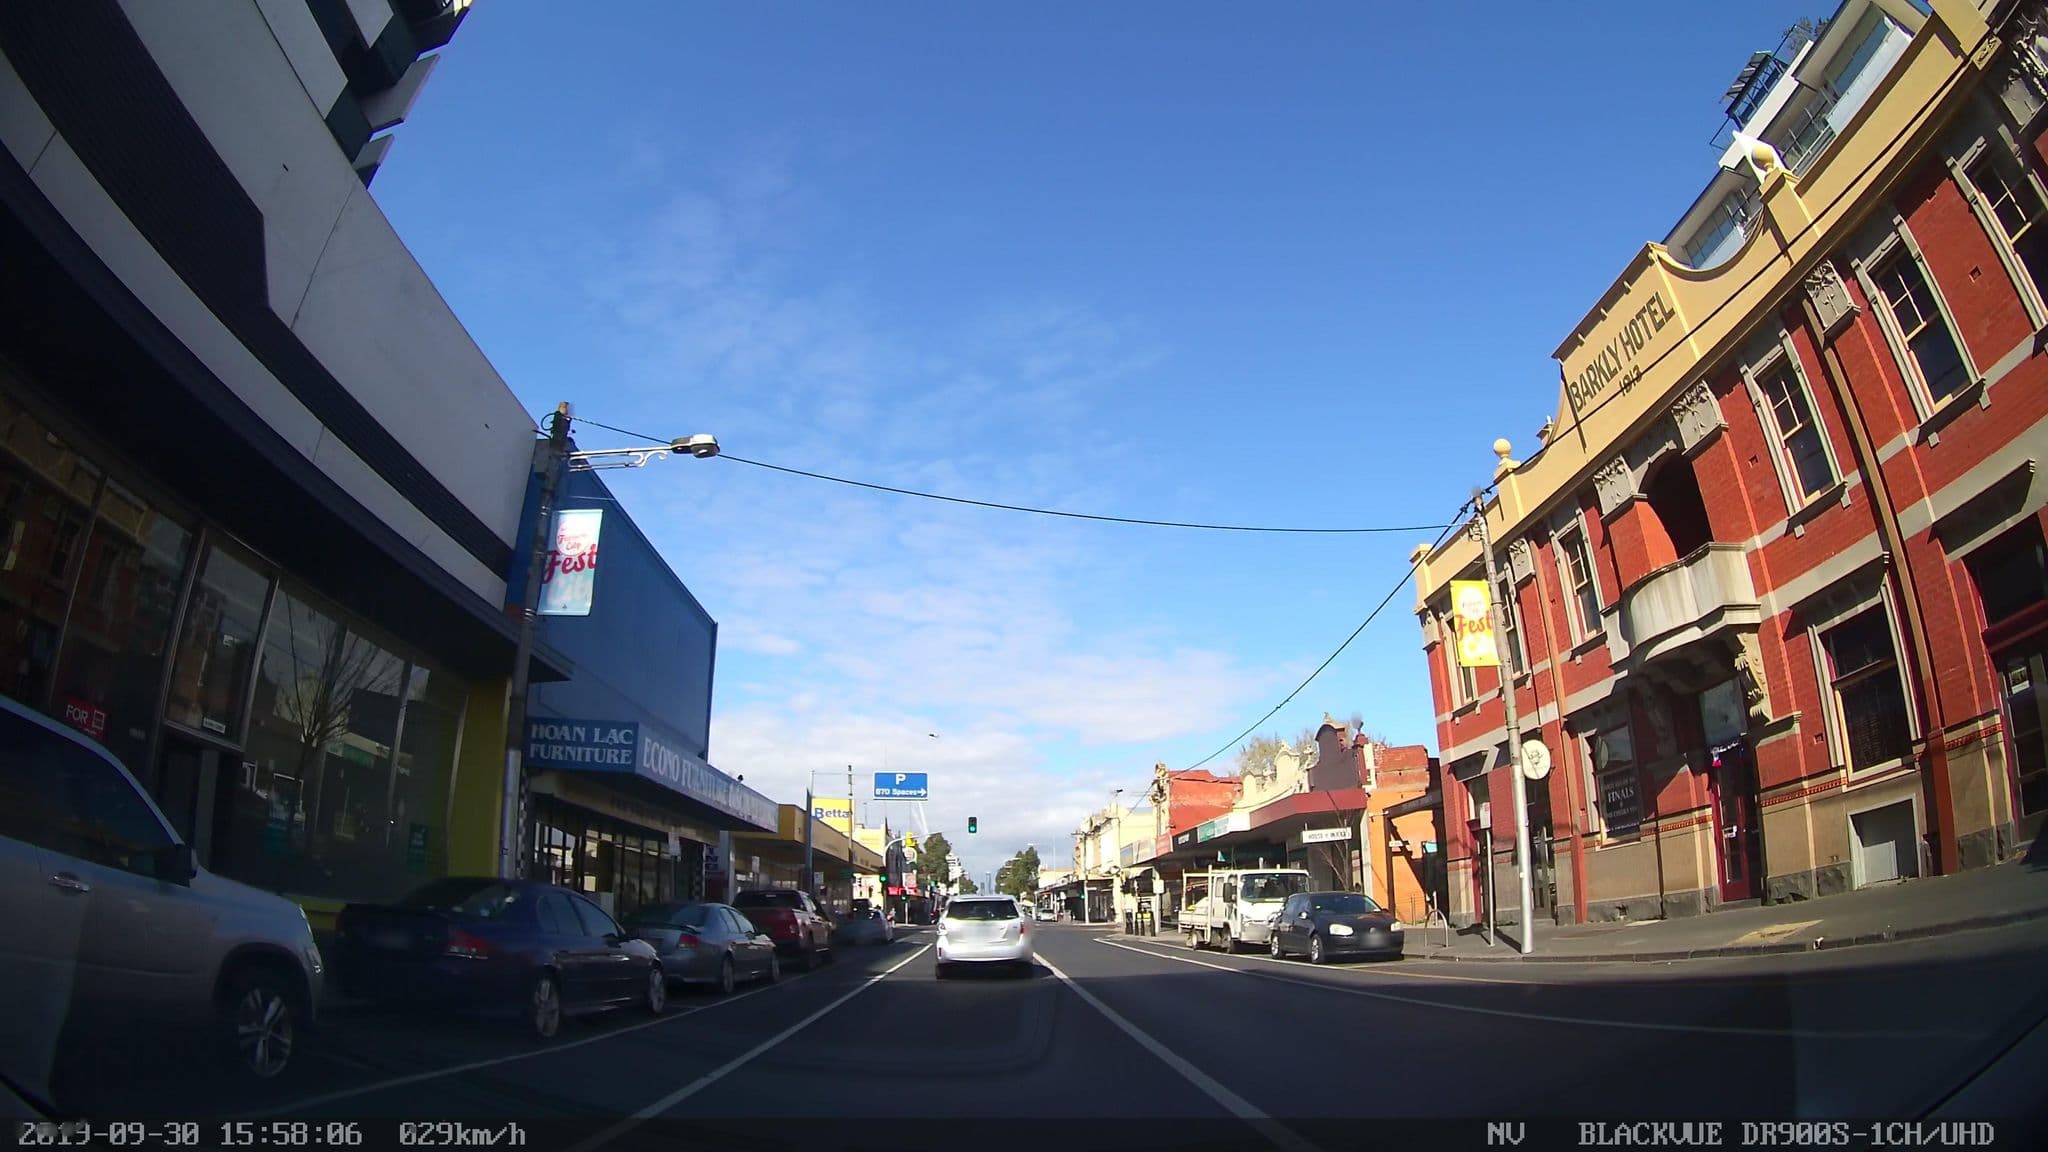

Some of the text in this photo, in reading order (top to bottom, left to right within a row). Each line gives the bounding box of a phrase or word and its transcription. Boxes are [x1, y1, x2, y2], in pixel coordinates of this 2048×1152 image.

[1570, 291, 1675, 412] BARKLY HOTEL
[1619, 364, 1643, 396] 1913
[543, 543, 599, 584] Fest
[1455, 609, 1494, 640] Fest
[66, 704, 87, 724] FOR
[531, 724, 633, 745] HOAN LAC
[529, 743, 633, 765] FURNITURE
[643, 736, 680, 783] ECONO
[895, 774, 906, 785] P
[892, 788, 917, 796] Spaces
[1608, 786, 1635, 804] FINALS
[814, 807, 852, 819] Betta
